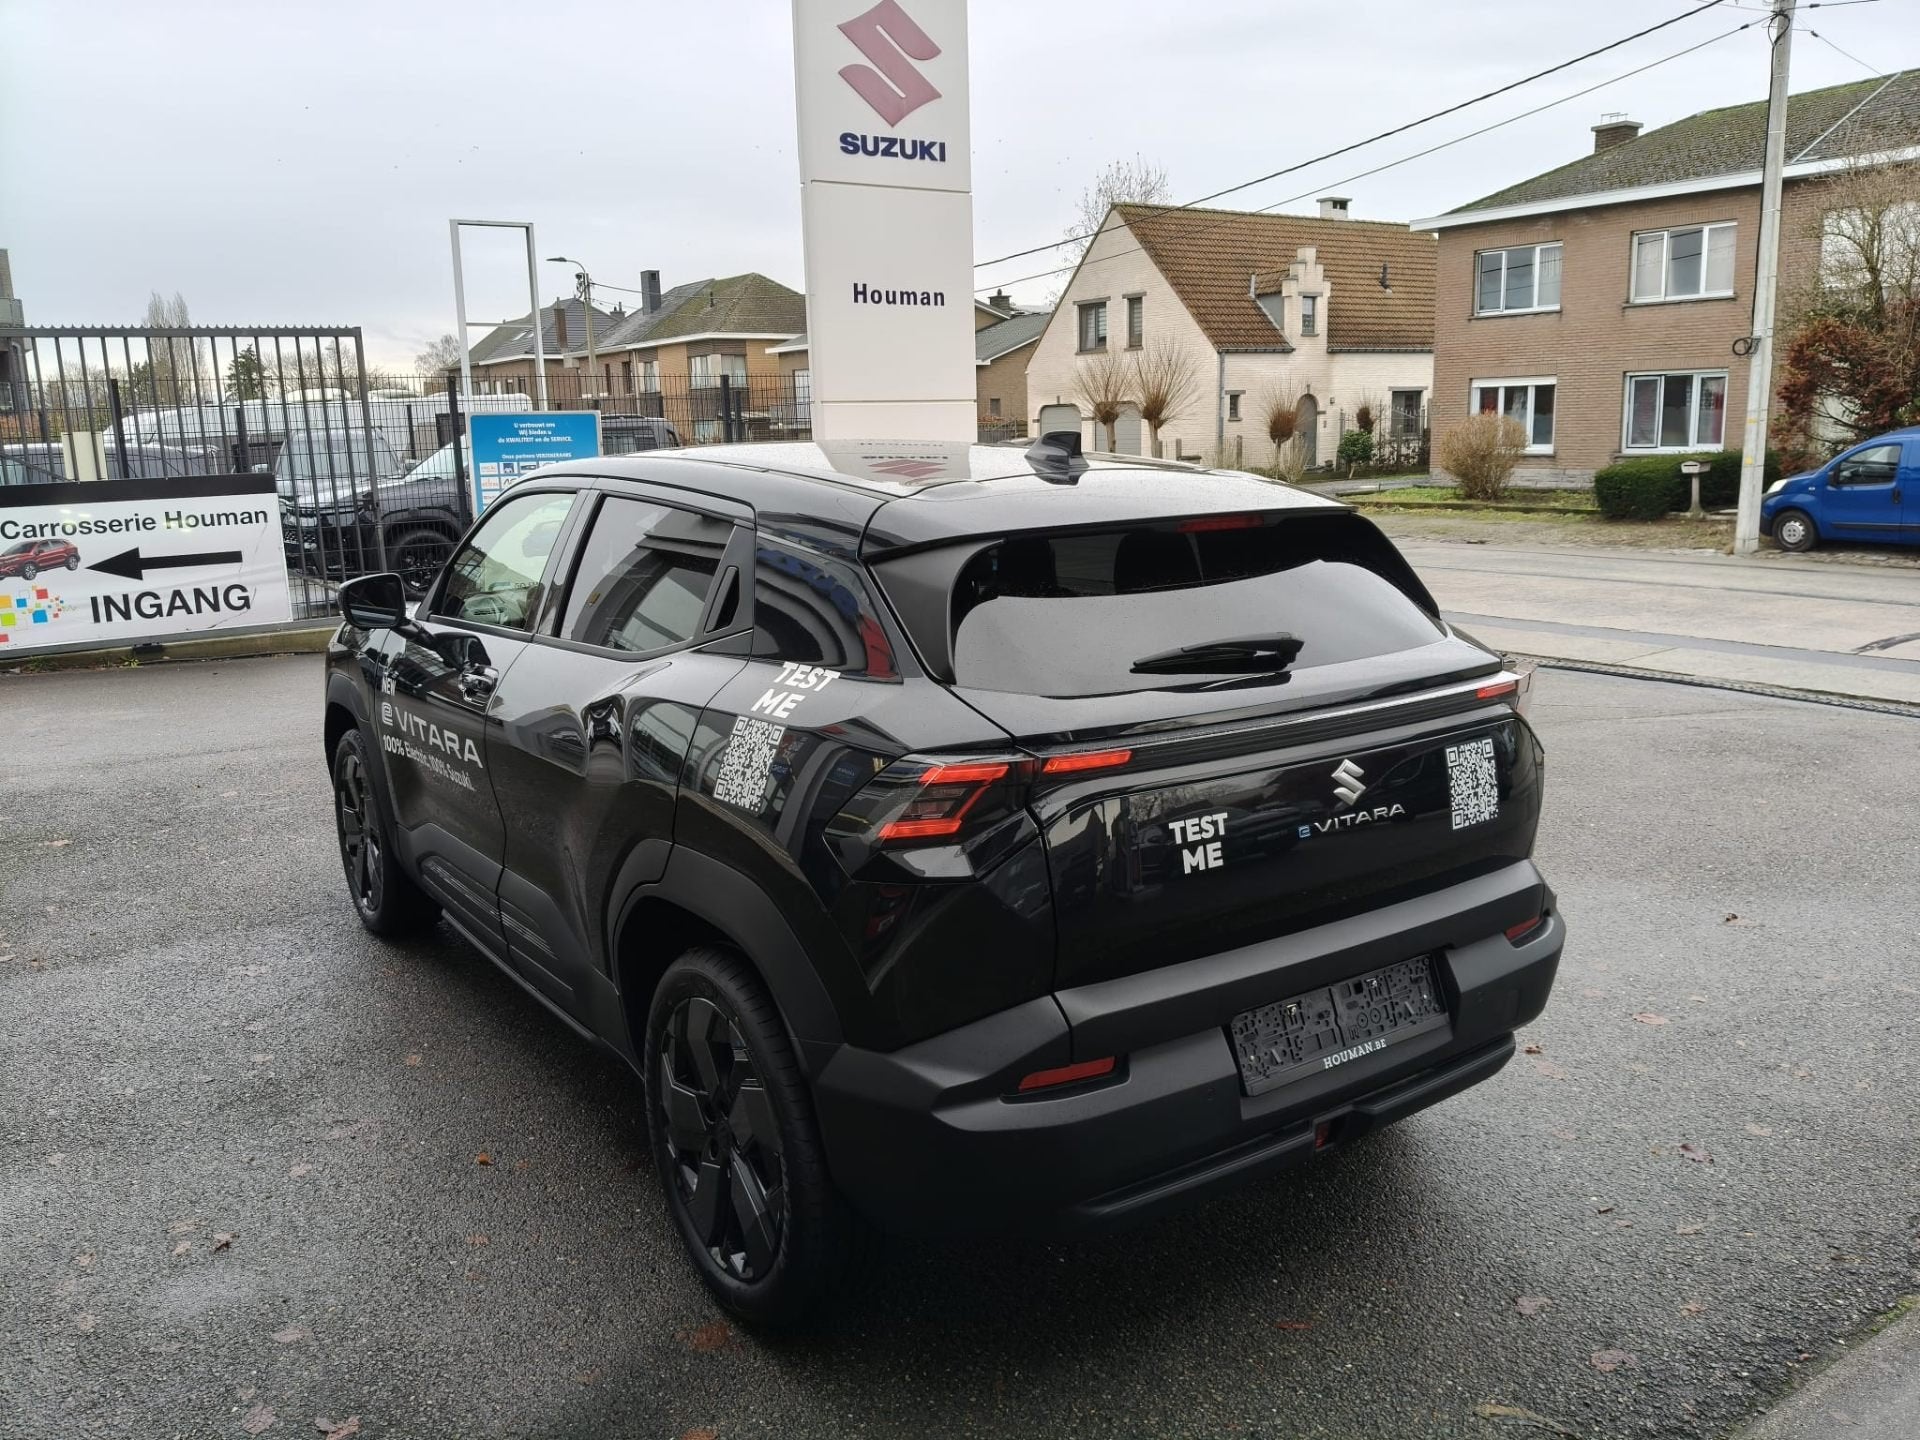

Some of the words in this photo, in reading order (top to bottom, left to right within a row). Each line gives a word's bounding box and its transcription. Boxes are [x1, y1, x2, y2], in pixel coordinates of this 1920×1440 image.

[839, 130, 947, 163] SUZUKI
[852, 281, 946, 307] Houman
[518, 429, 528, 437] Wij
[0, 512, 157, 540] Carrosserie
[164, 510, 269, 530] Houman
[90, 584, 252, 624] INGANG
[381, 678, 397, 696] NEW
[773, 661, 841, 692] TEST
[751, 688, 806, 719] ME
[383, 734, 405, 756] 100%
[394, 706, 484, 769] VITARA
[1168, 812, 1229, 845] TEST
[1313, 804, 1406, 833] VITARA
[1182, 841, 1225, 875] ME
[1323, 1038, 1387, 1069] HOUMAN.BE
